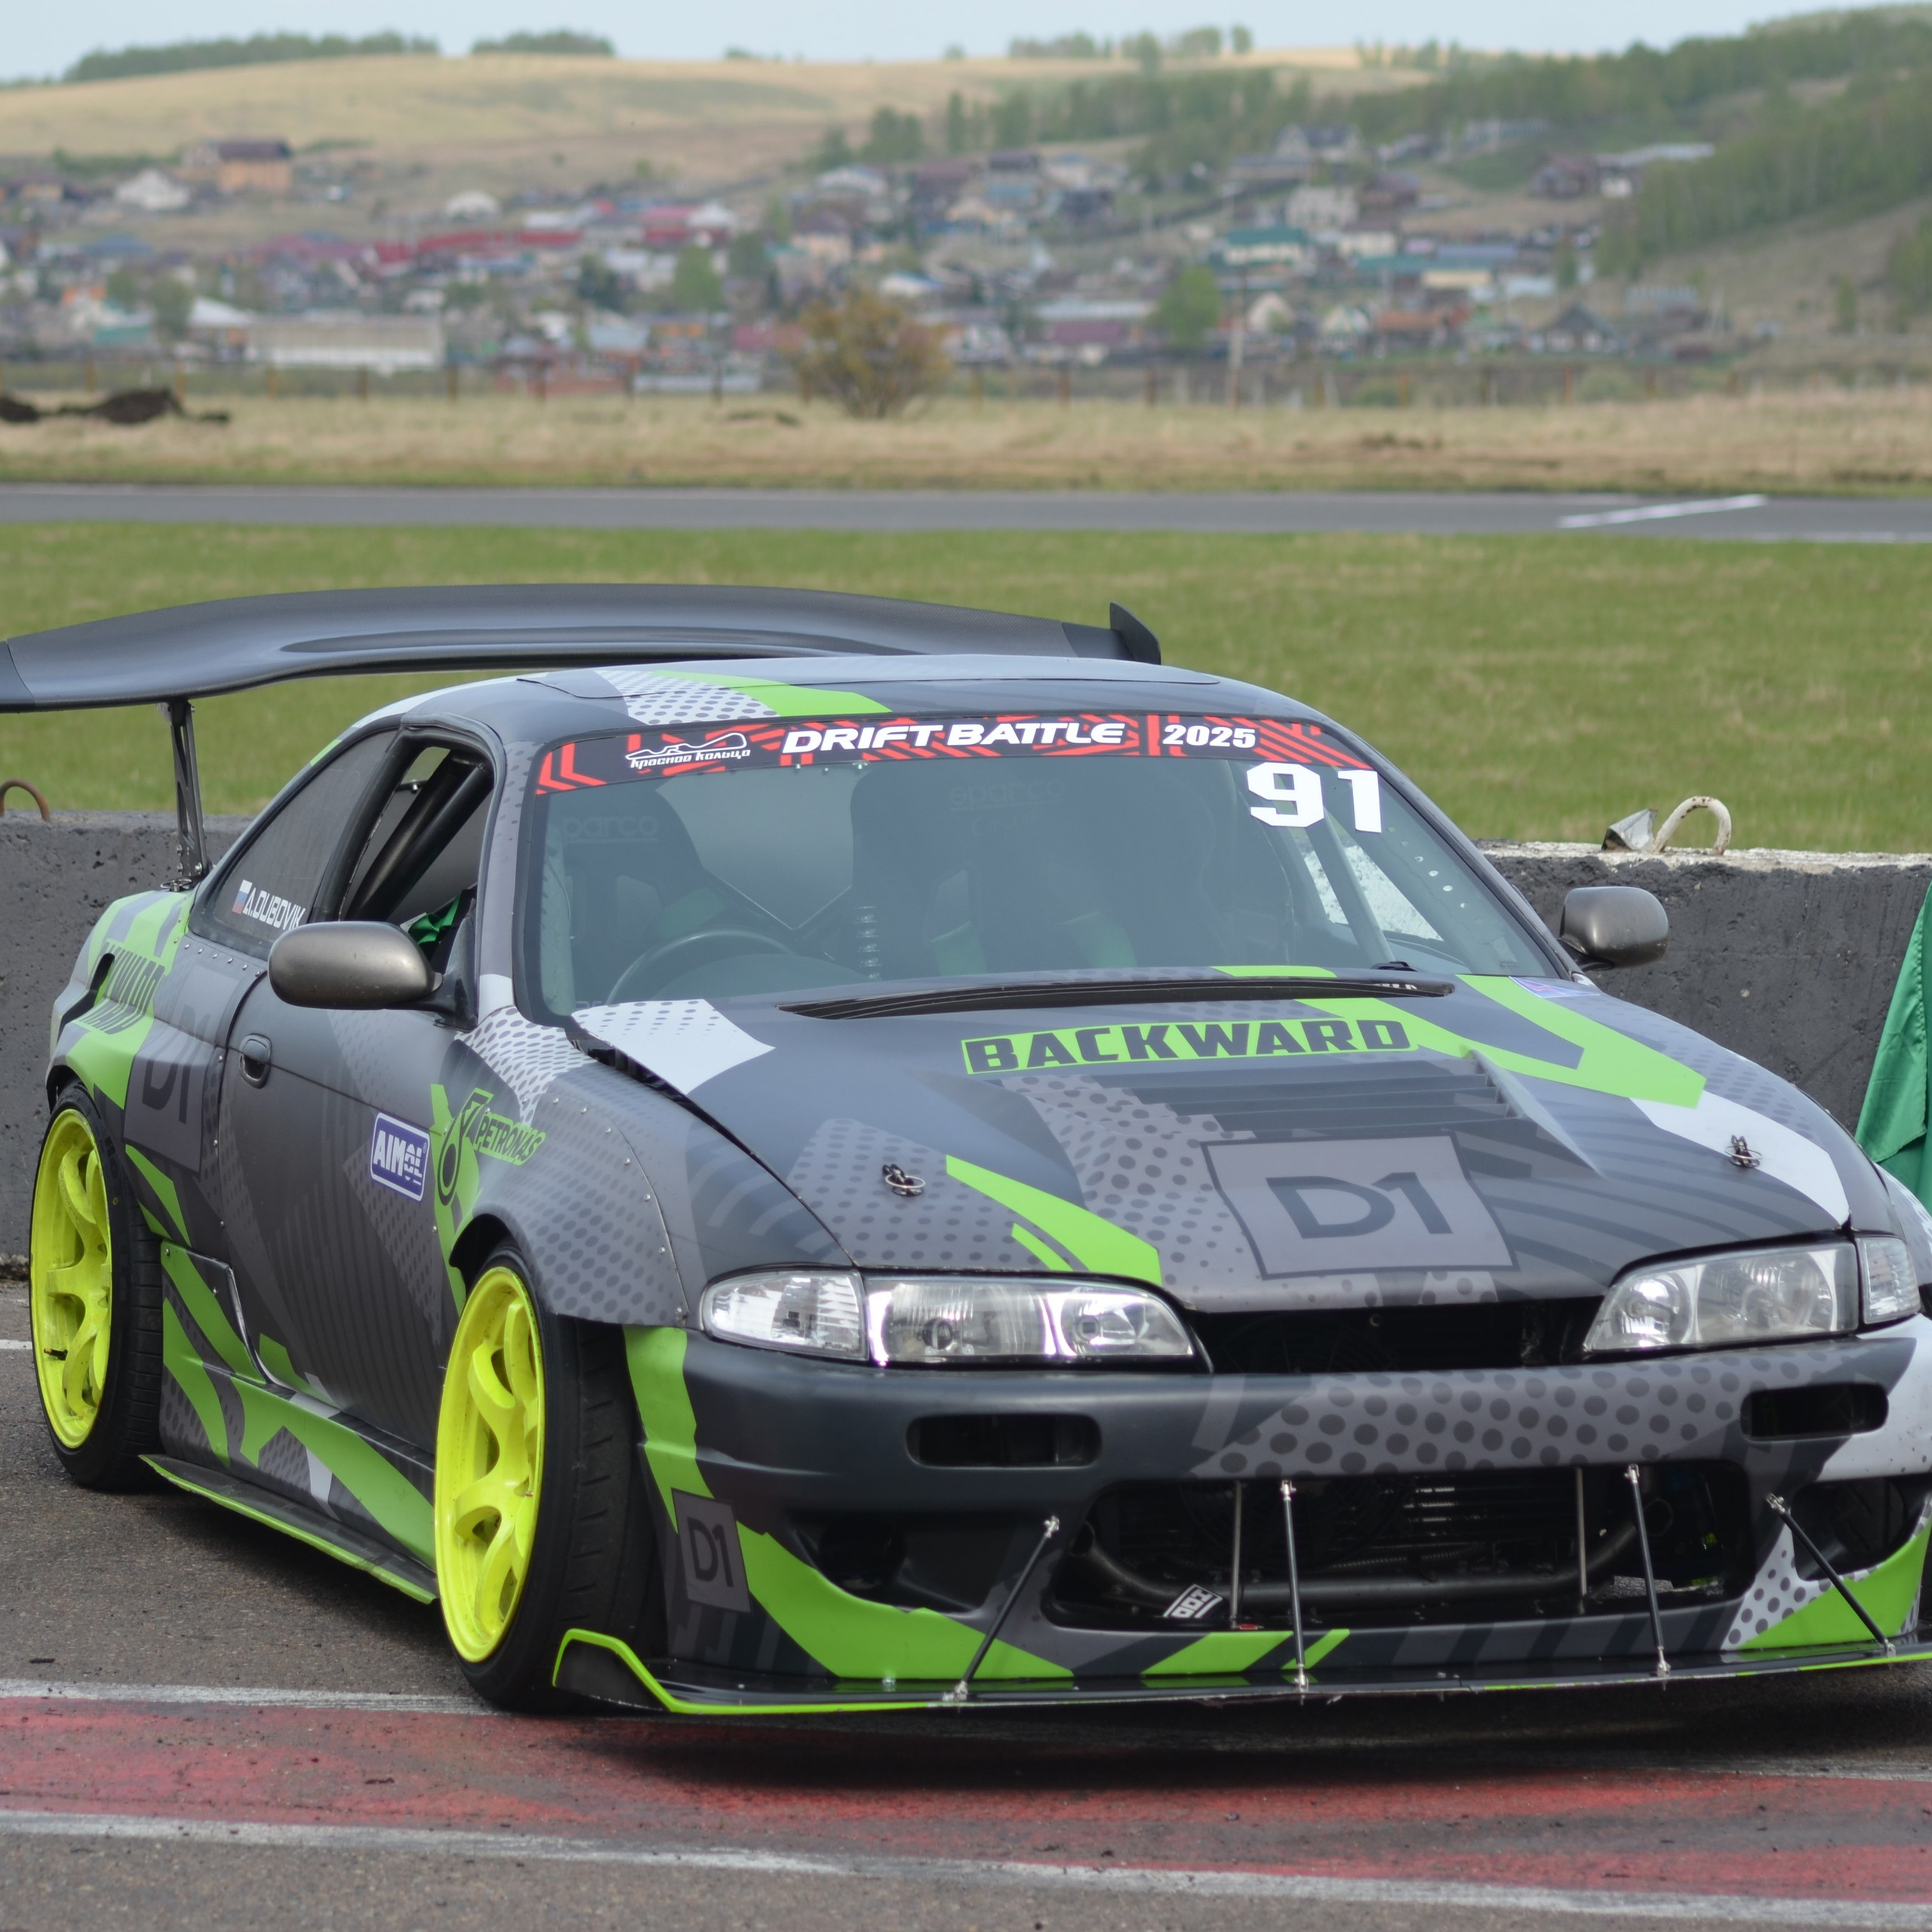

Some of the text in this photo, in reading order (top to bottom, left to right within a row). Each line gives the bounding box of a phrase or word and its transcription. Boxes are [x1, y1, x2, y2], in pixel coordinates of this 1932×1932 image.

[781, 721, 1126, 755] DRIFT BATTLE
[1161, 723, 1257, 749] 2025
[1245, 761, 1383, 834] 91
[964, 1019, 1413, 1074] BACKWARD
[373, 1129, 423, 1186] AIMOL
[475, 1115, 543, 1162] PETRONAS
[1265, 1171, 1454, 1240] D1
[687, 1515, 734, 1588] D1
